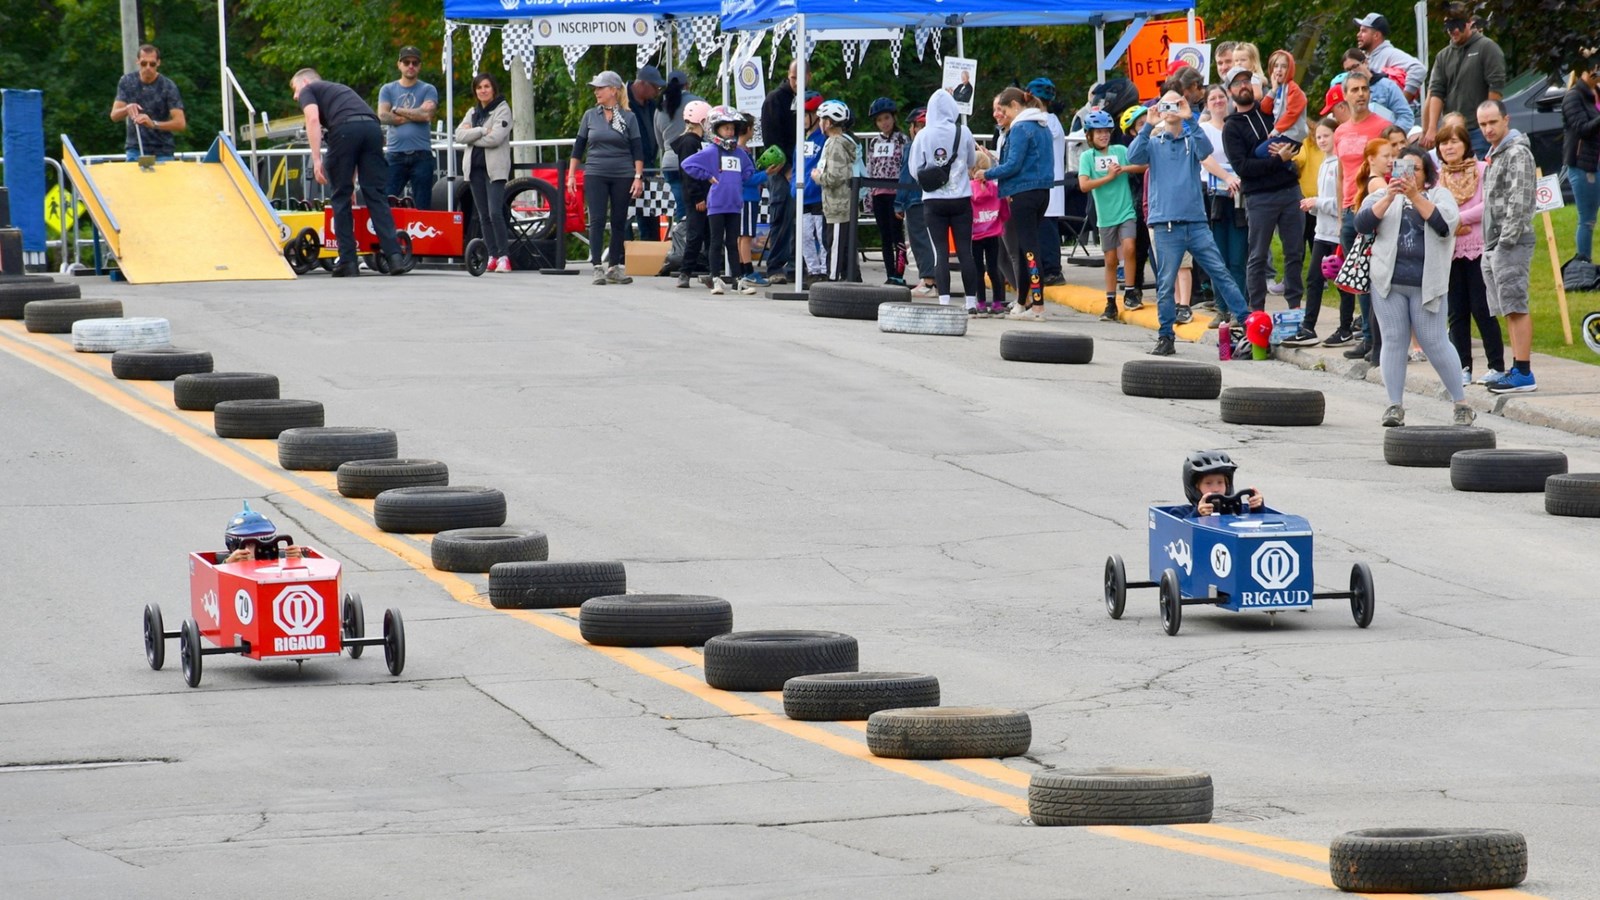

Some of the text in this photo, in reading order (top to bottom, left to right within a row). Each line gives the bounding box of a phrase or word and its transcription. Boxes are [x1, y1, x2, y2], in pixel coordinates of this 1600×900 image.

[557, 21, 626, 34] INSCRIPTION
[877, 145, 889, 155] 44
[726, 158, 738, 169] 37
[1215, 549, 1227, 572] 87
[1241, 590, 1310, 606] RIGAUD
[239, 594, 249, 619] 79
[274, 634, 326, 652] RIGAUD
